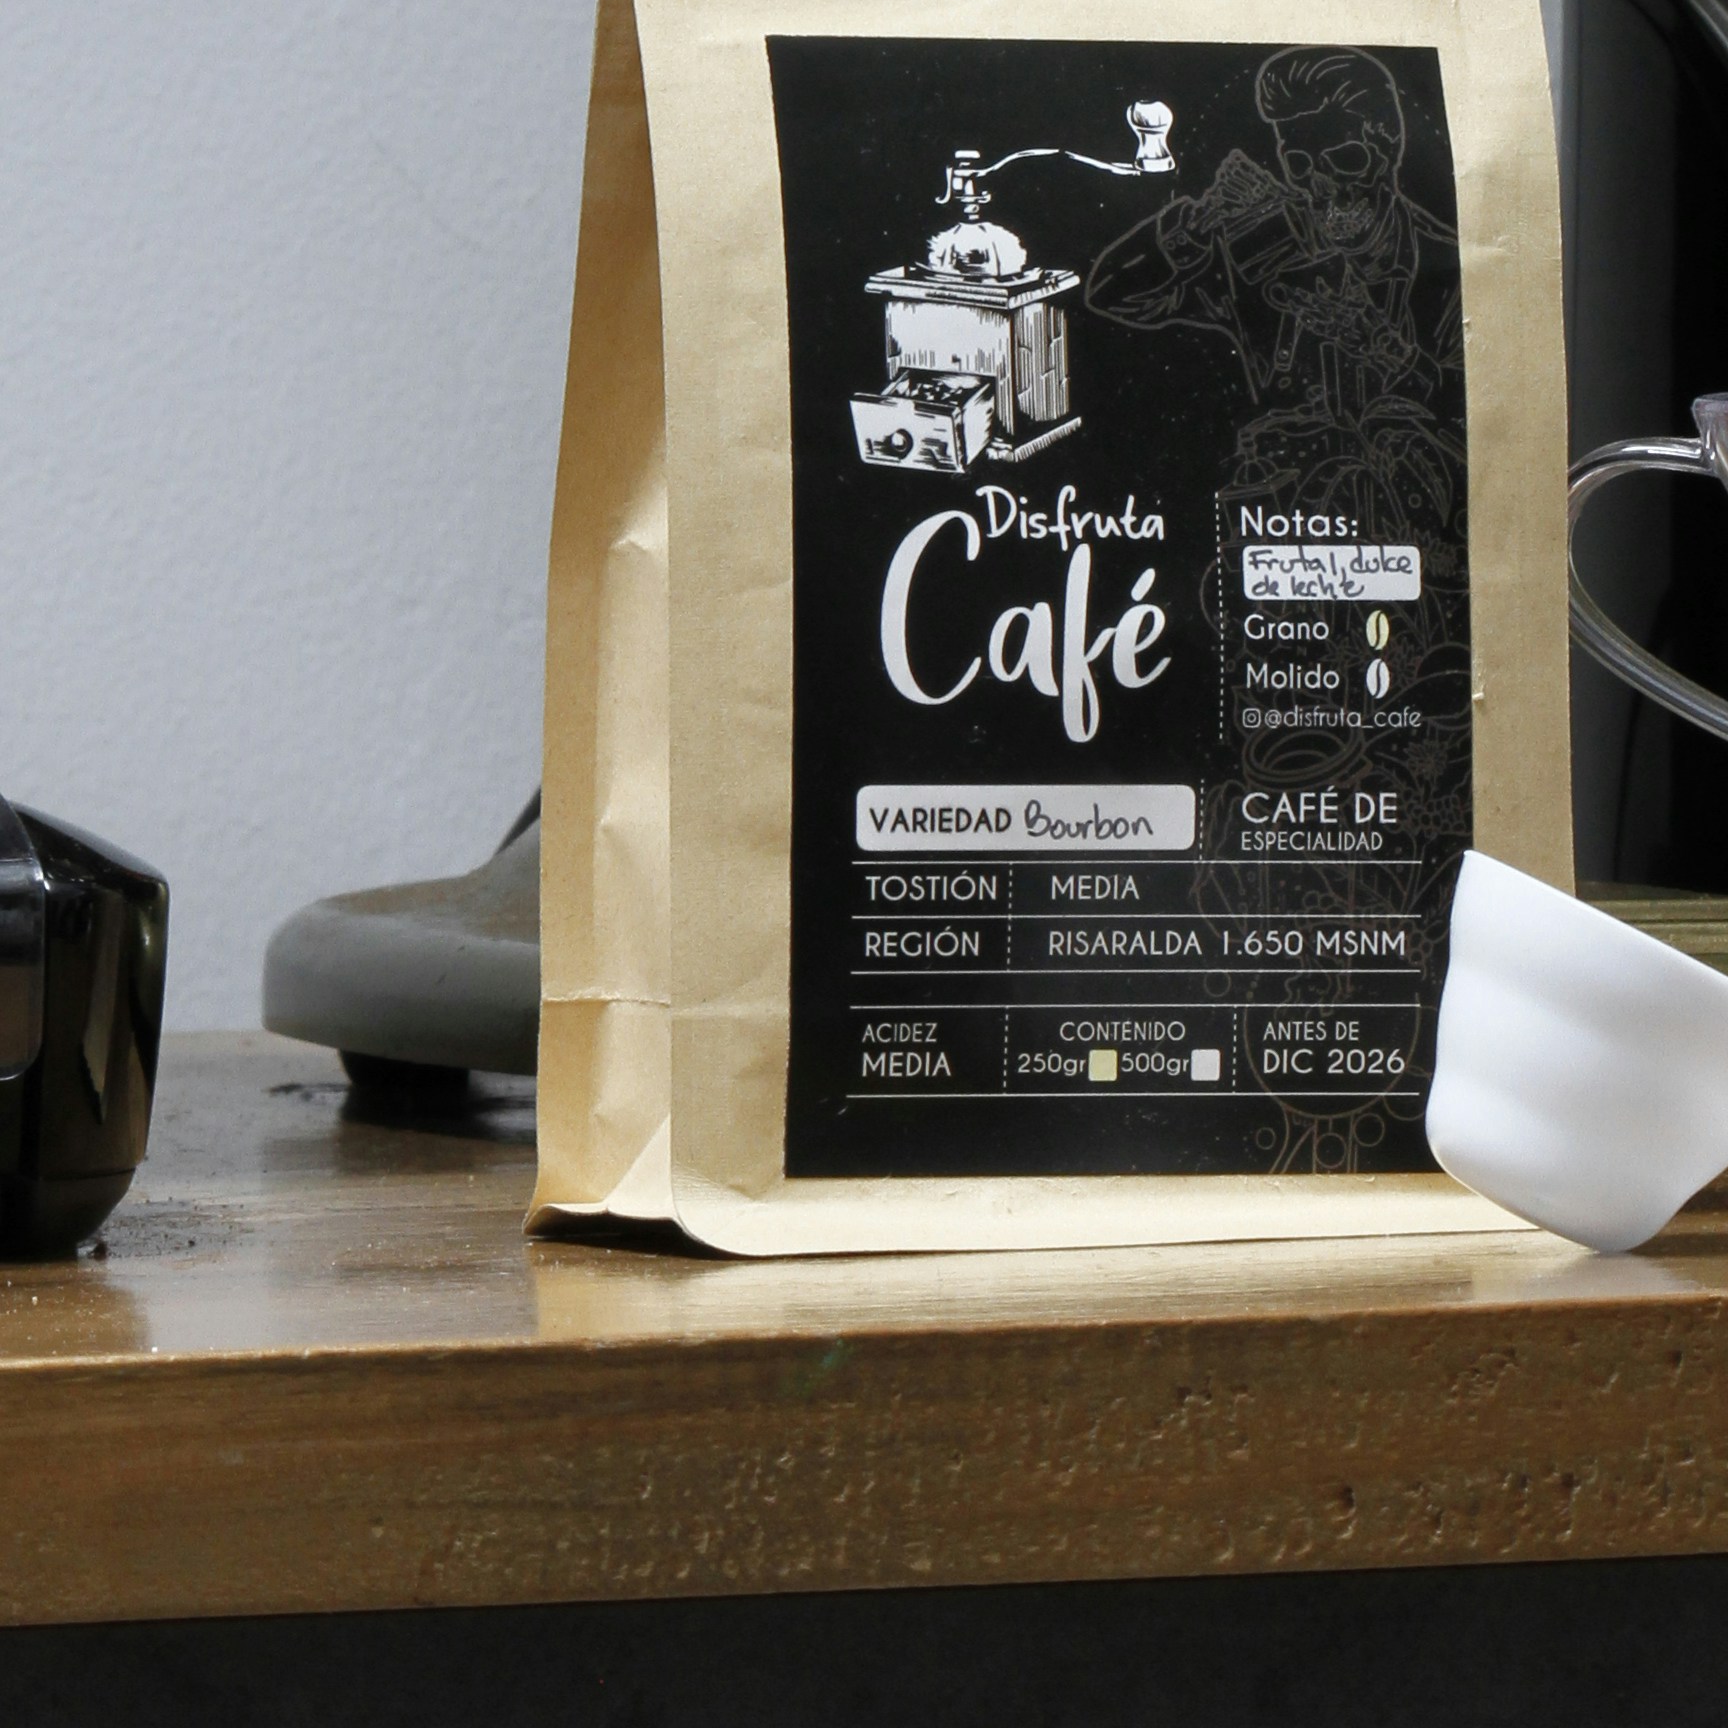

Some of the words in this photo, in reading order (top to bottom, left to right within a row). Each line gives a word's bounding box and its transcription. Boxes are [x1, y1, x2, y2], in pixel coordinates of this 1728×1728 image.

[976, 485, 1164, 552] Disfruta
[1240, 505, 1358, 537] Notas:
[1251, 575, 1280, 597] de
[880, 510, 1172, 743] Café
[1243, 613, 1330, 640] Grano
[1246, 662, 1340, 690] Molido
[1264, 705, 1421, 729] @disfruta_cafe
[1241, 785, 1339, 824] CAFÉ
[1354, 792, 1398, 824] DE
[869, 807, 1012, 834] VARIEDAD
[1024, 800, 1153, 841] Bourbon
[1241, 830, 1383, 851] ESPECIALIDAD
[865, 870, 997, 901] TOSTIÓN
[1051, 874, 1140, 900] MEDIA
[865, 926, 979, 957] REGIÓN
[1049, 930, 1203, 956] RISARALDA
[1222, 930, 1304, 956] 1.650
[1316, 930, 1406, 956] MSNM
[862, 1022, 937, 1043] ACIDEZ
[1059, 1020, 1186, 1042] CONTENIDO
[1263, 1020, 1327, 1042] ANTES
[1335, 1021, 1359, 1042] DE
[862, 1052, 951, 1077] MEDIA
[1018, 1052, 1086, 1077] 250gr
[1121, 1051, 1190, 1076] 500gr
[1263, 1048, 1313, 1074] DIC
[1327, 1048, 1406, 1074] 2026
